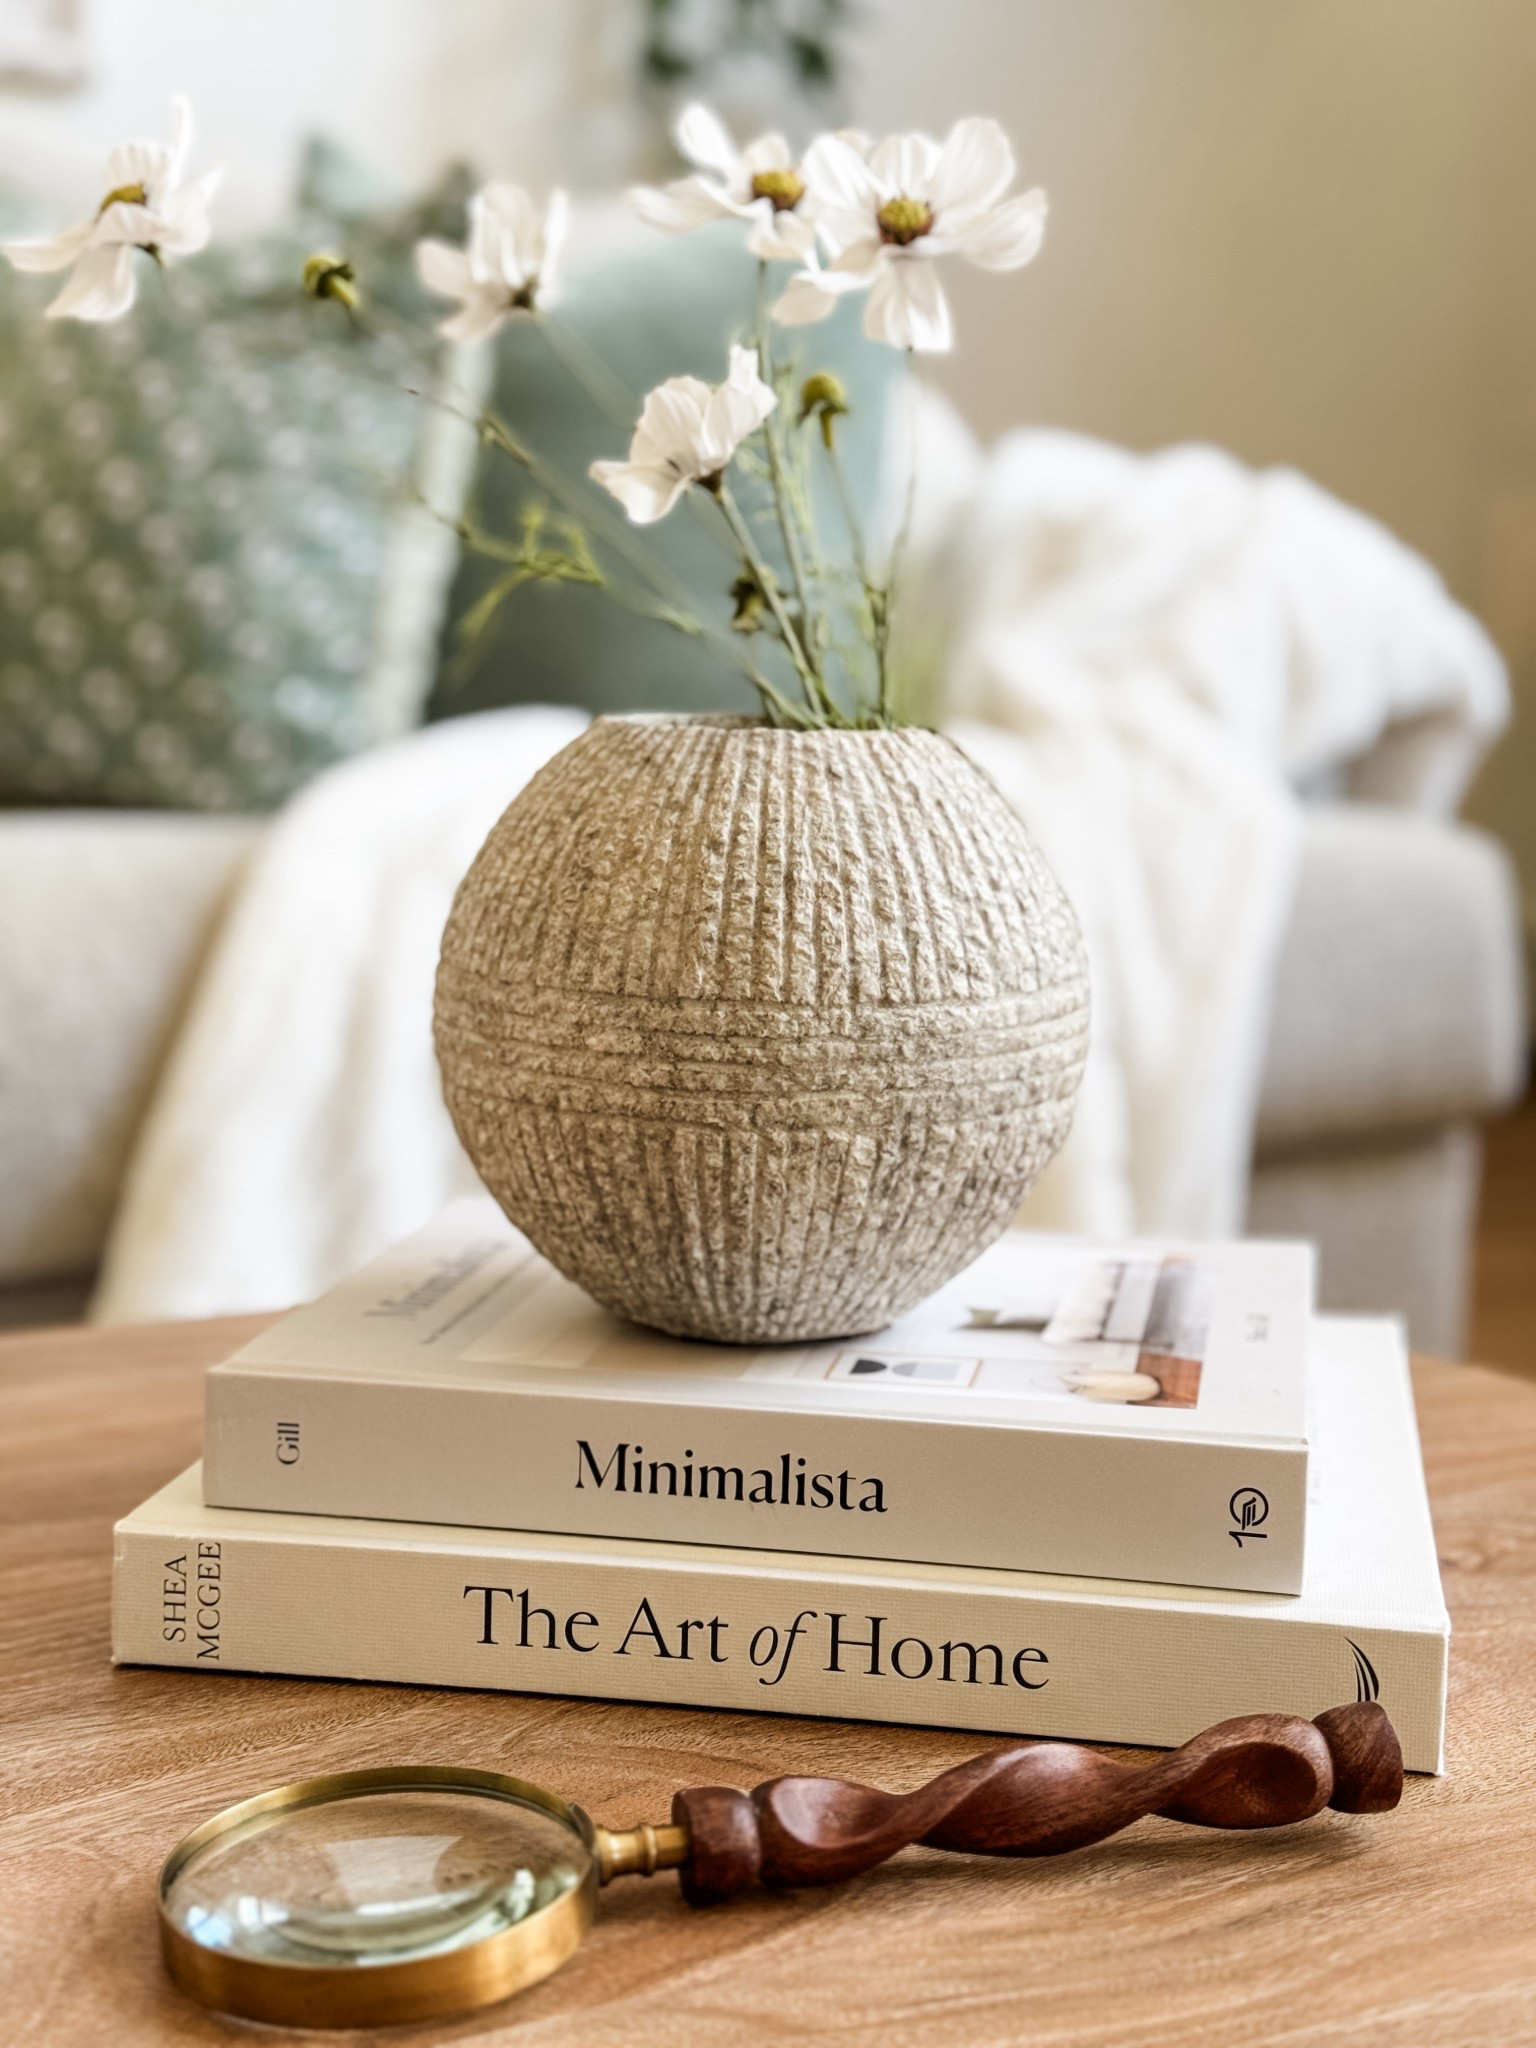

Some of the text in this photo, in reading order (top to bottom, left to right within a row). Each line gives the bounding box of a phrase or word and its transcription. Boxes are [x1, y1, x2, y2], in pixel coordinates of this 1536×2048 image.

[276, 1421, 301, 1466] Gill
[574, 1439, 889, 1515] Minimalista
[162, 1552, 188, 1644] SHEA
[196, 1541, 222, 1661] MCGEE
[462, 1584, 1051, 1691] The Art of Home
